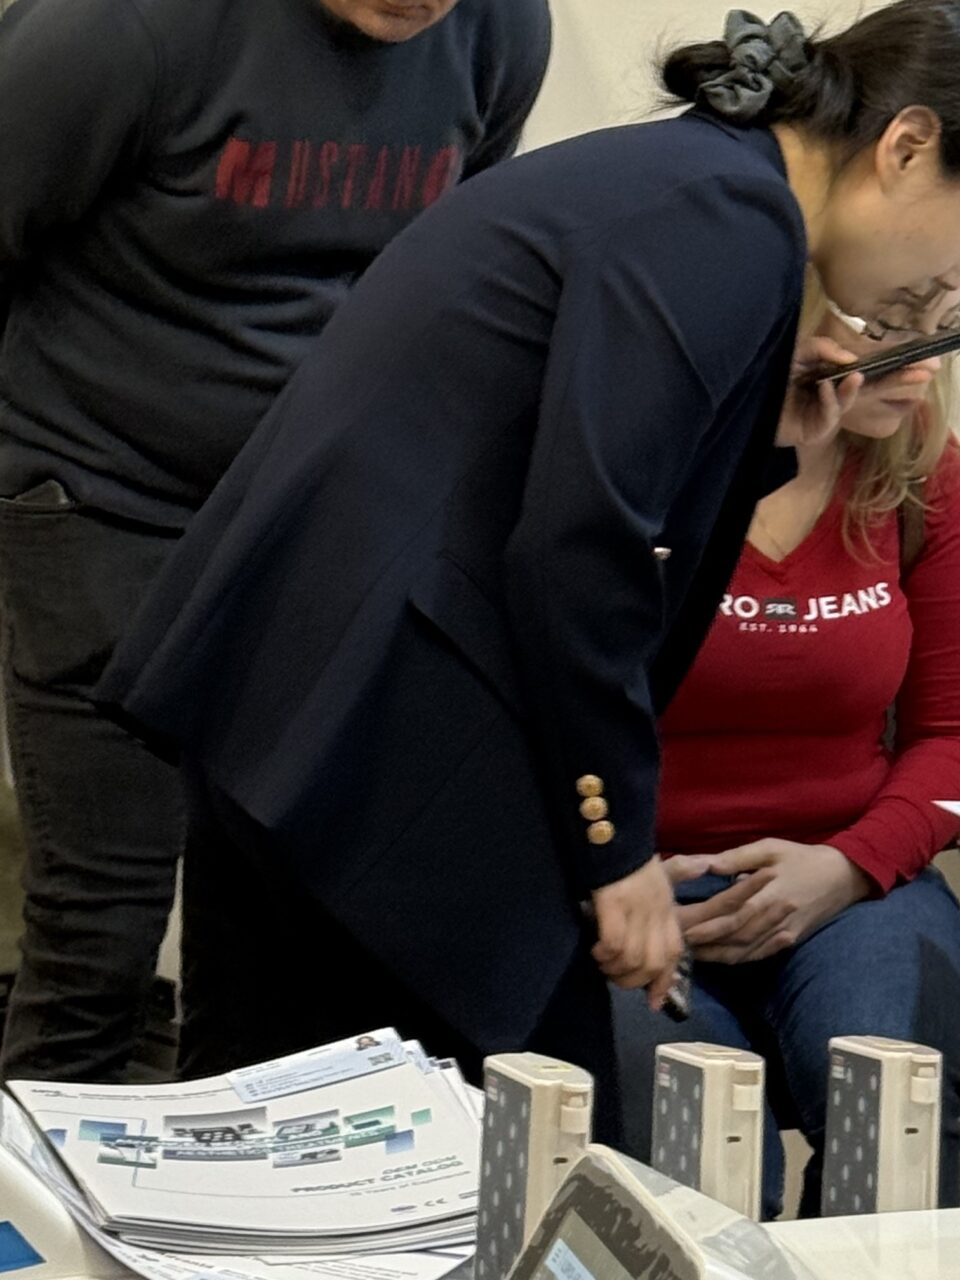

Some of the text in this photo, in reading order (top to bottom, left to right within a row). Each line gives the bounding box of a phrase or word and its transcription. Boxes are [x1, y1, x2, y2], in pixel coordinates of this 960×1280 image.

[803, 581, 892, 621] JEANS
[291, 1161, 464, 1193] PRODUCT CATALOG
